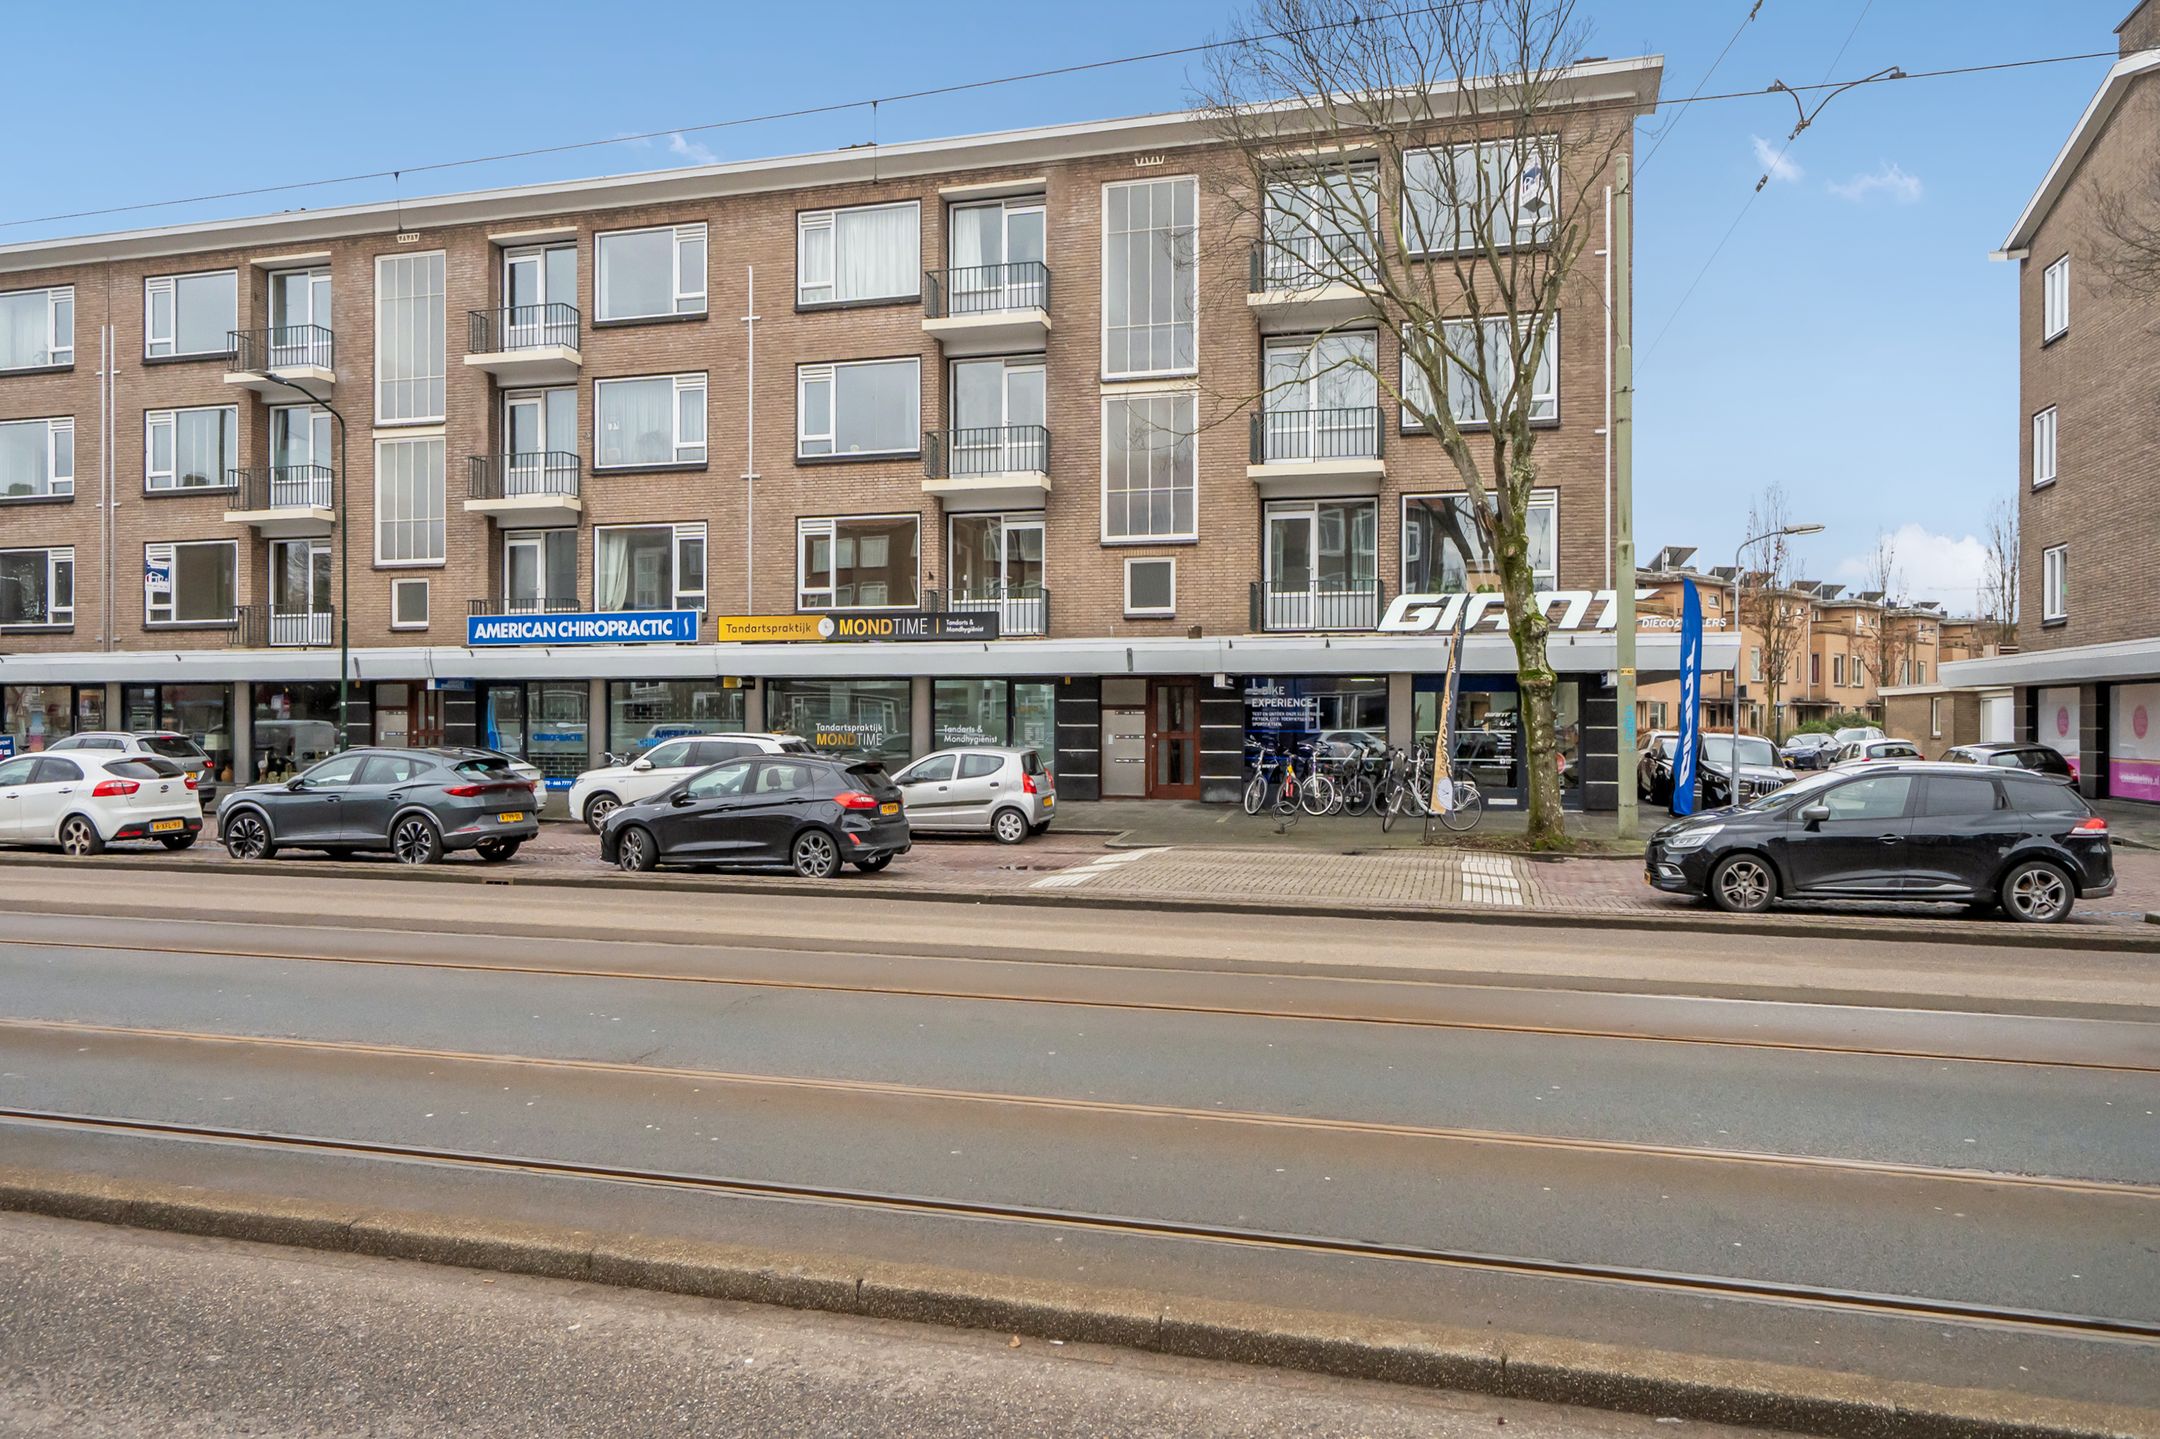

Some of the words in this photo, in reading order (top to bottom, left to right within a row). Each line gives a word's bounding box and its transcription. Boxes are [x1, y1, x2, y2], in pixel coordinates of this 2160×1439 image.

[839, 617, 928, 636] MONDTIME
[946, 618, 969, 626] Tandarts
[474, 620, 556, 639] AMERICAN
[558, 618, 673, 638] CHIROPRACTIC
[726, 622, 812, 636] Tandartspraktijk
[1252, 698, 1313, 707] EXPERIENCE
[816, 723, 883, 733] Tandartspraktijk
[944, 725, 975, 734] Tandarts
[816, 733, 883, 746] MONDTIME
[944, 734, 998, 744] Mondhygiënist
